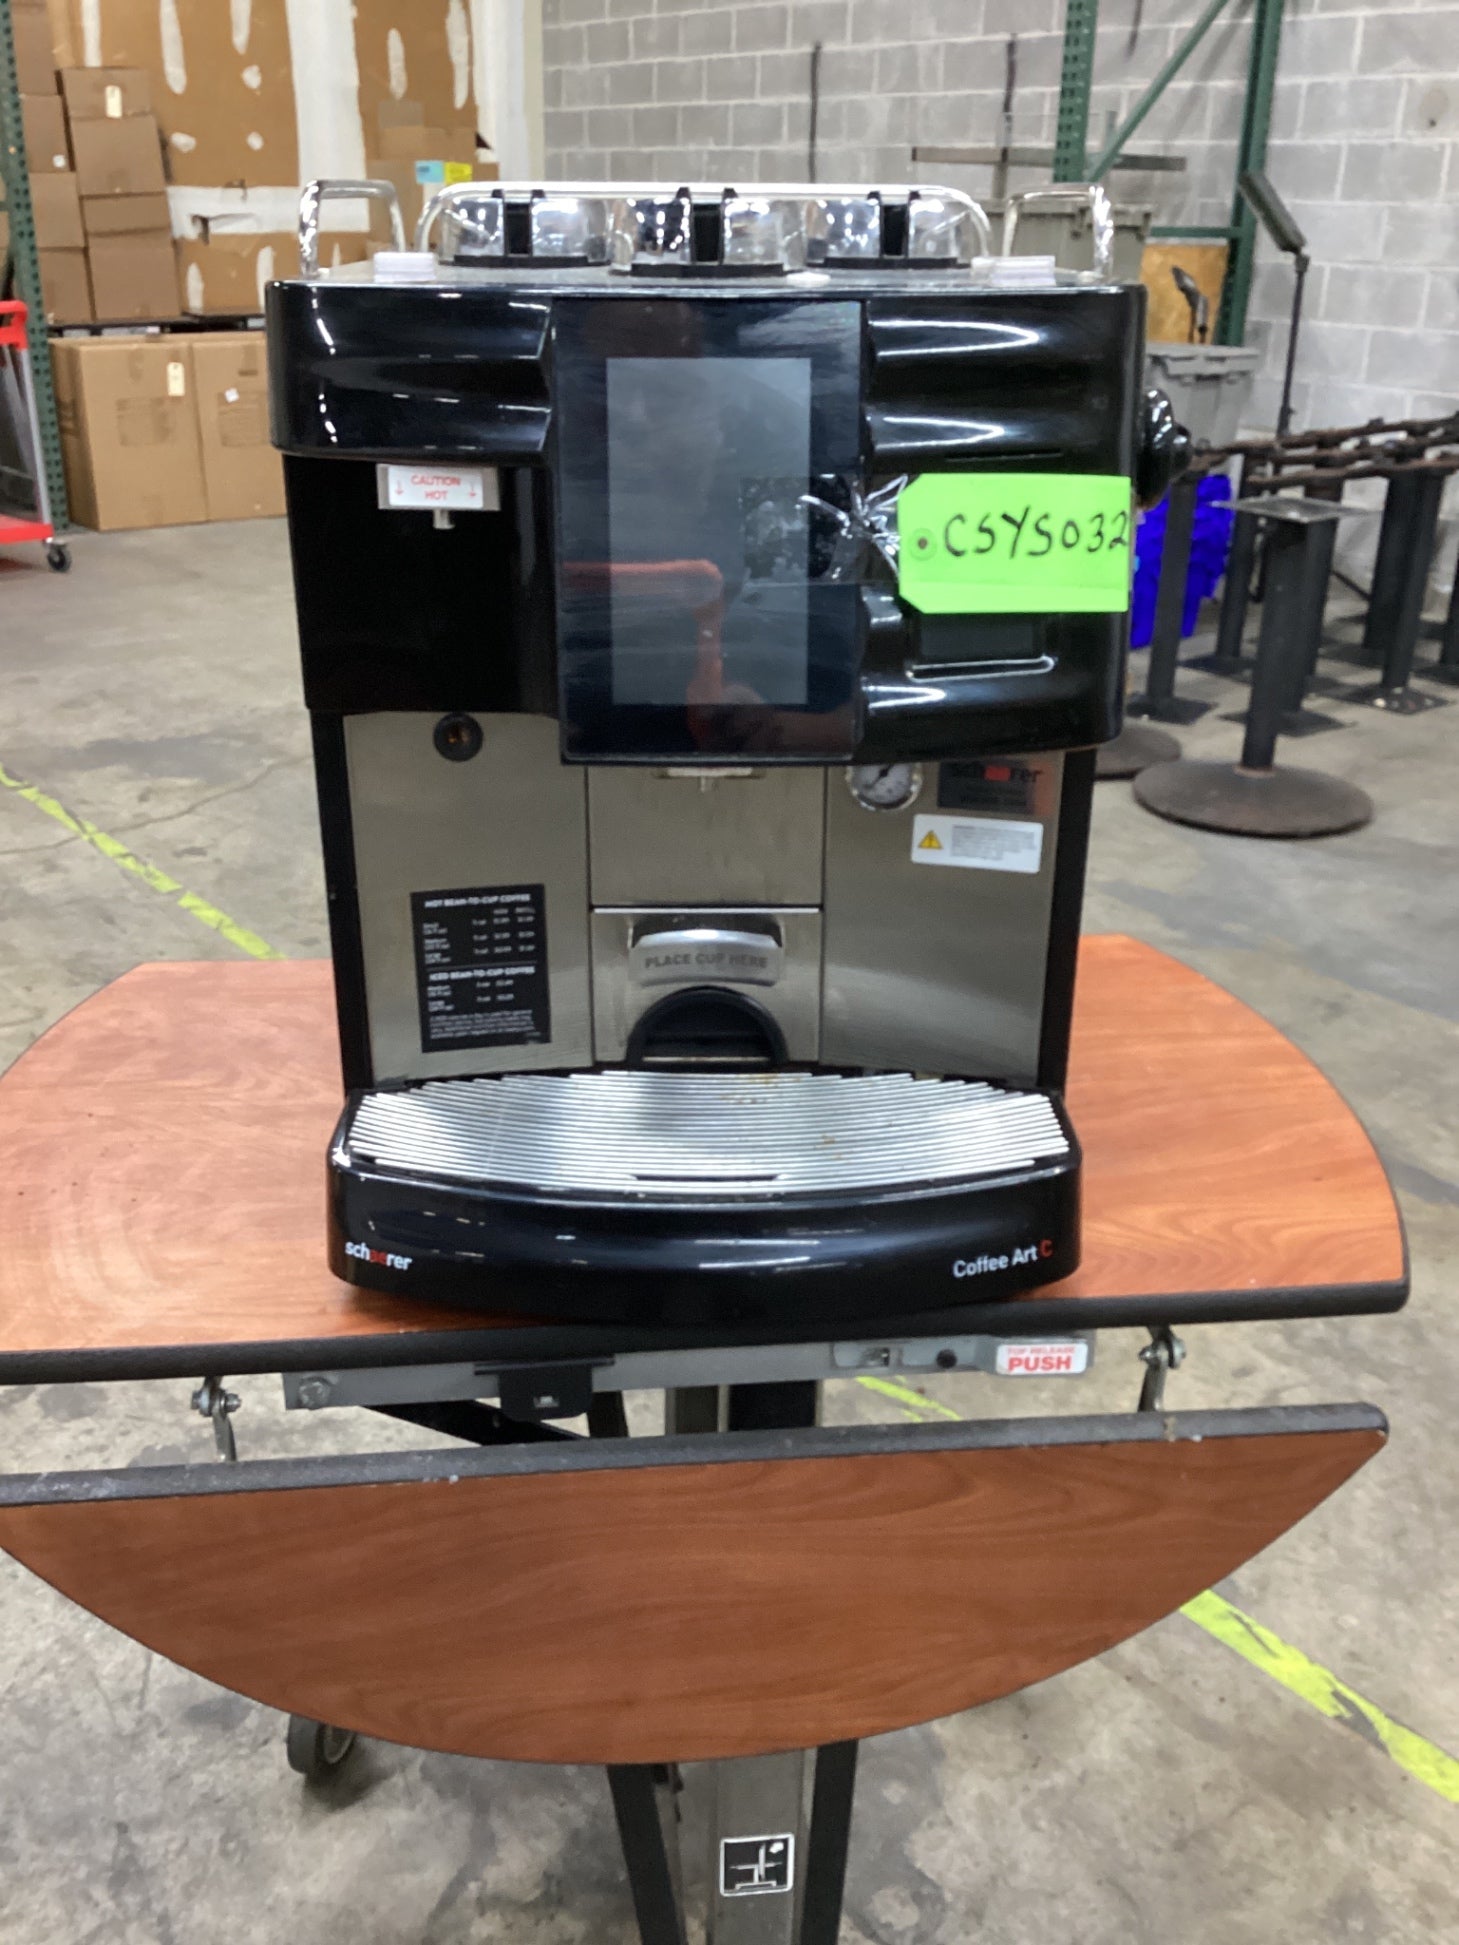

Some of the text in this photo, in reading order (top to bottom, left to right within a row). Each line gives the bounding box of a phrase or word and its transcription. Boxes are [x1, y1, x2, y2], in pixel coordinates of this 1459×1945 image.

[411, 474, 461, 486] CAUTION
[425, 490, 448, 500] HOT
[645, 952, 768, 968] PLACE CUP HERE
[953, 1239, 1053, 1278] Coffee Art C
[1008, 1356, 1071, 1372] PUSH
